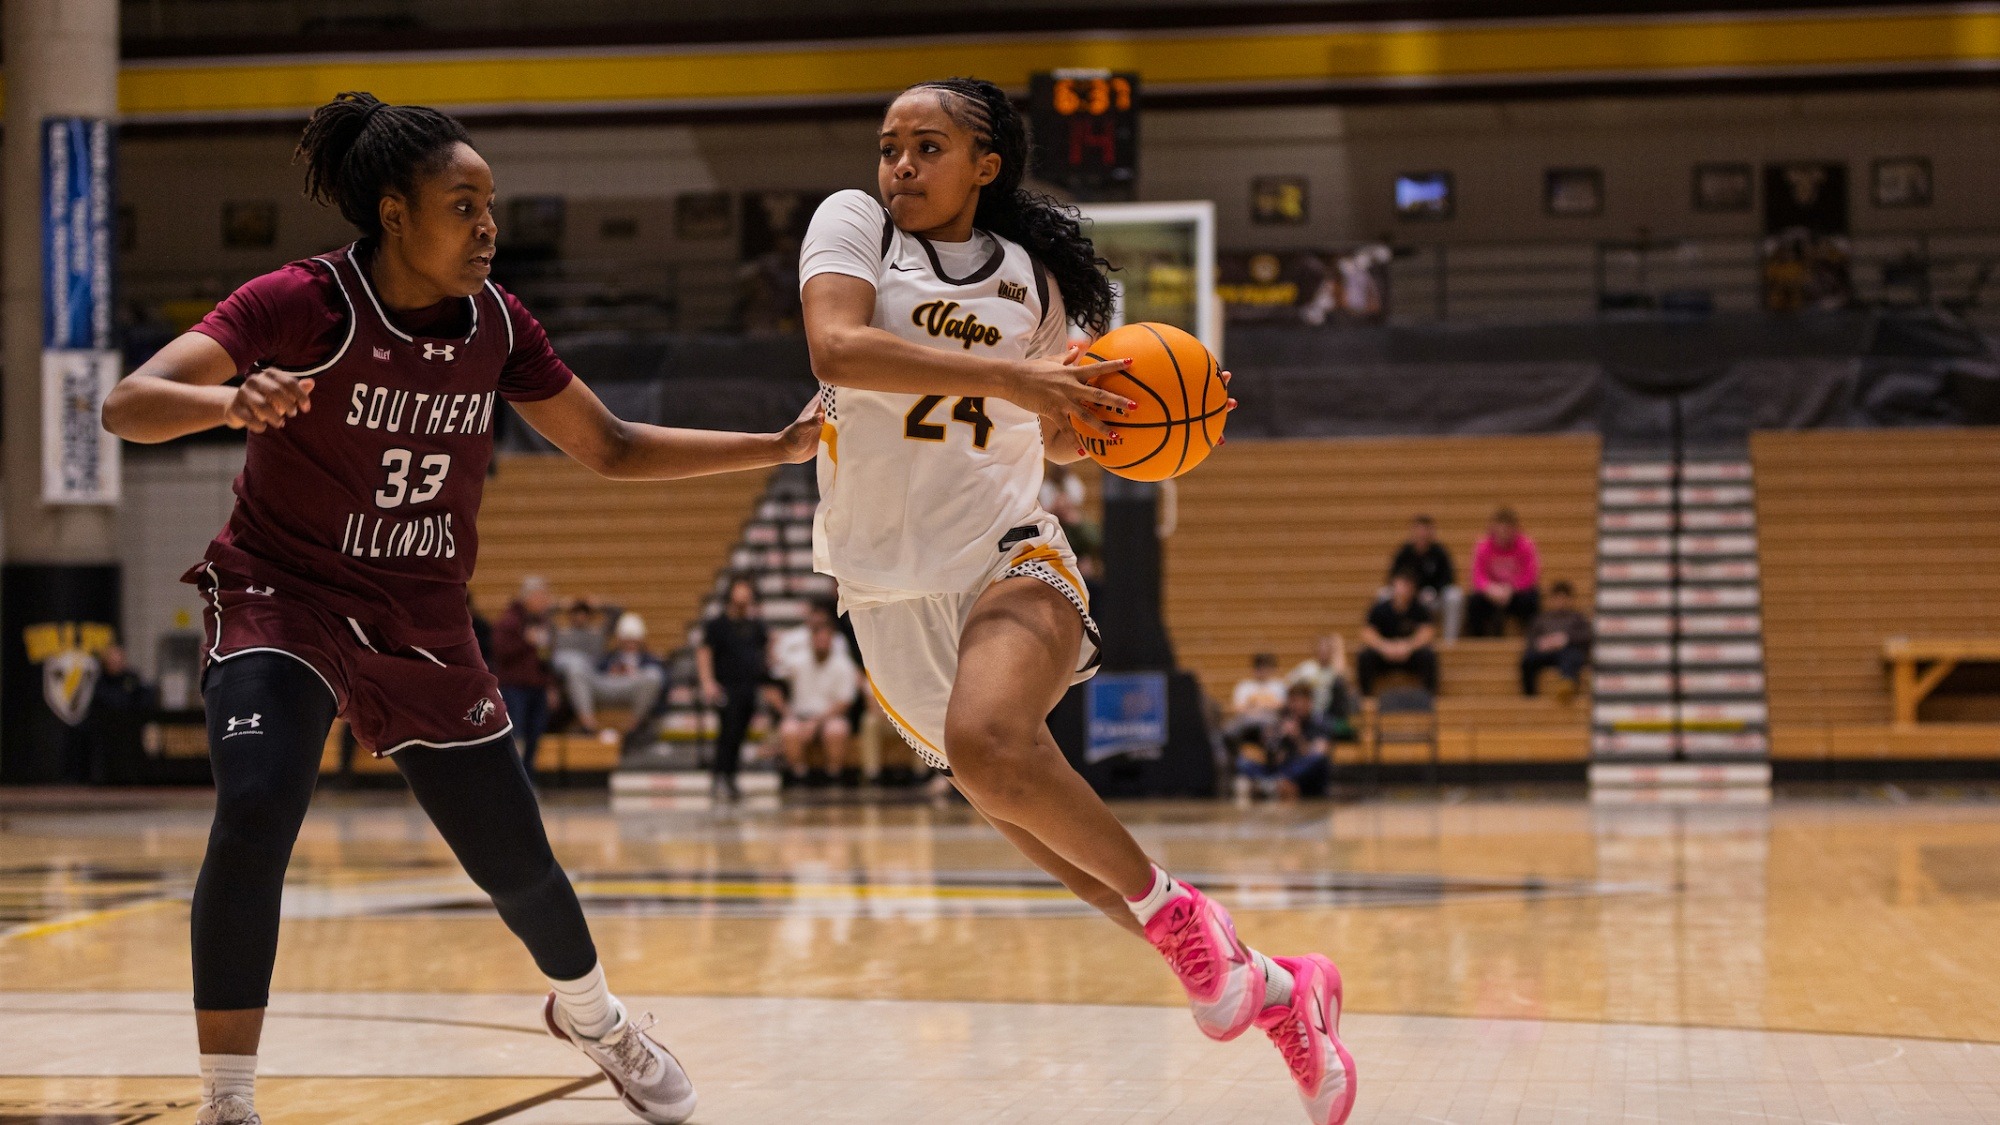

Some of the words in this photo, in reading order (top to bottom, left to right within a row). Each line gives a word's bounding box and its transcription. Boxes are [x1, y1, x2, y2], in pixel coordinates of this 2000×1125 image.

[998, 279, 1028, 302] VALLEY
[911, 299, 1003, 350] Valpo
[346, 382, 496, 435] SOUTHERN
[903, 394, 995, 451] 24
[1105, 437, 1124, 447] NXT
[375, 448, 451, 509] 33
[341, 512, 456, 559] ILLINOIS
